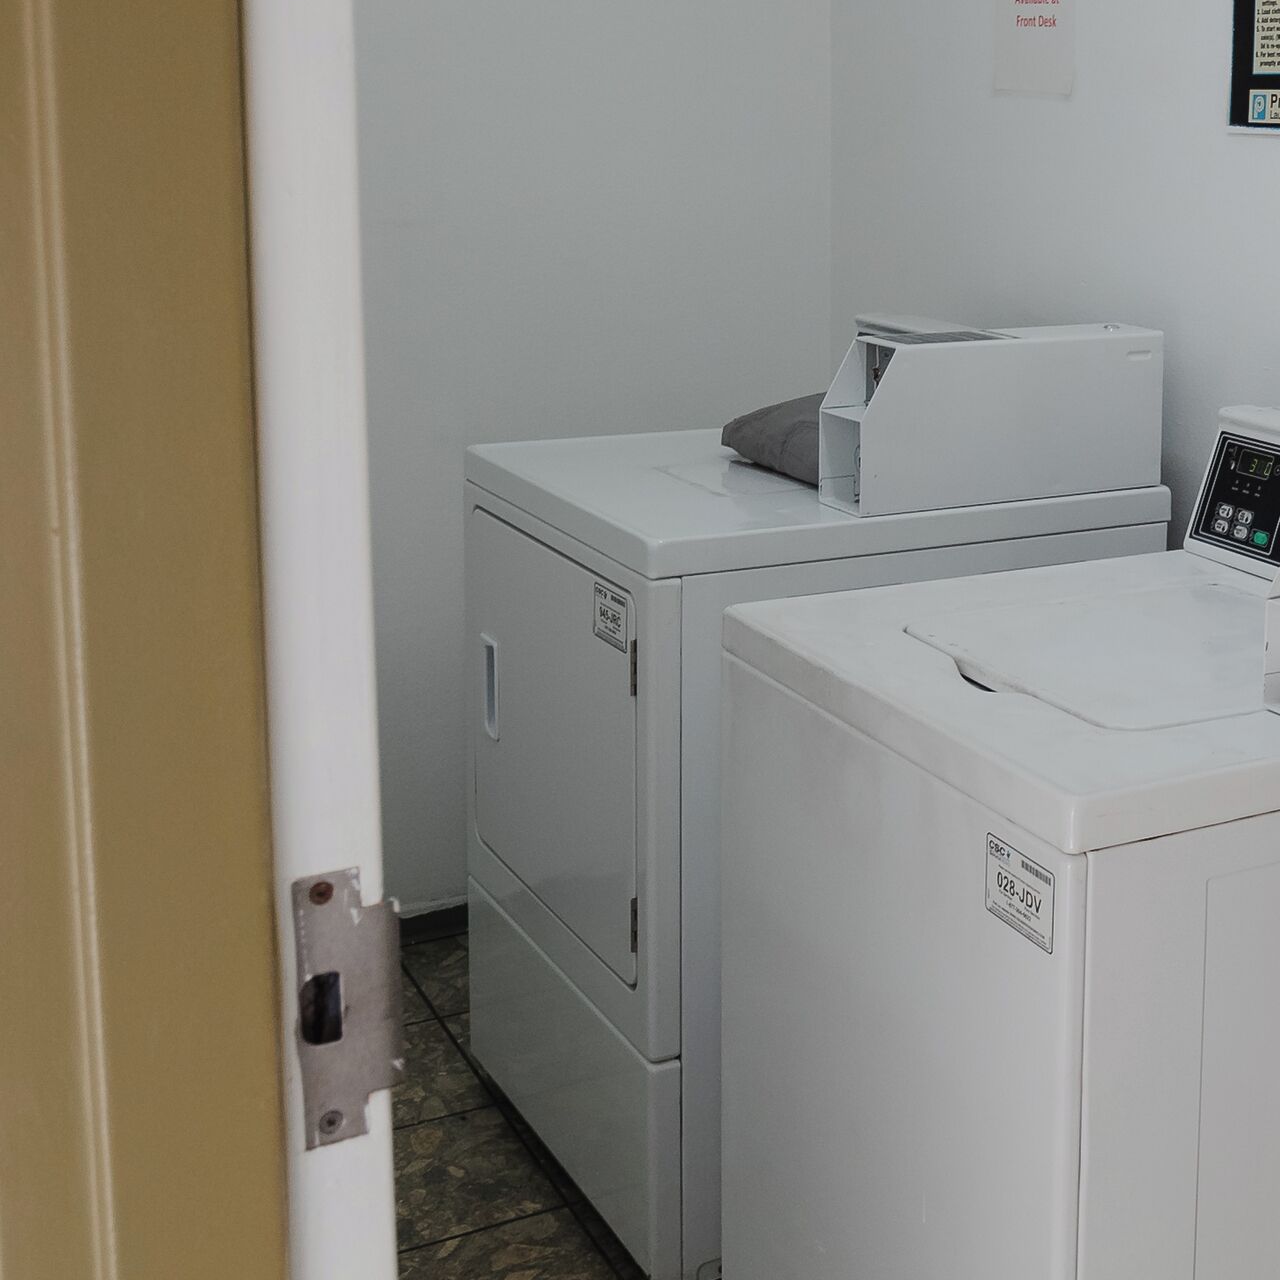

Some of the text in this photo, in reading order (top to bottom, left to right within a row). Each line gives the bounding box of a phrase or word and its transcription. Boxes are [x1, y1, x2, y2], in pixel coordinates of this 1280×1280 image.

[1016, 15, 1056, 27] Front Desk
[997, 871, 1041, 913] 028-JDV
